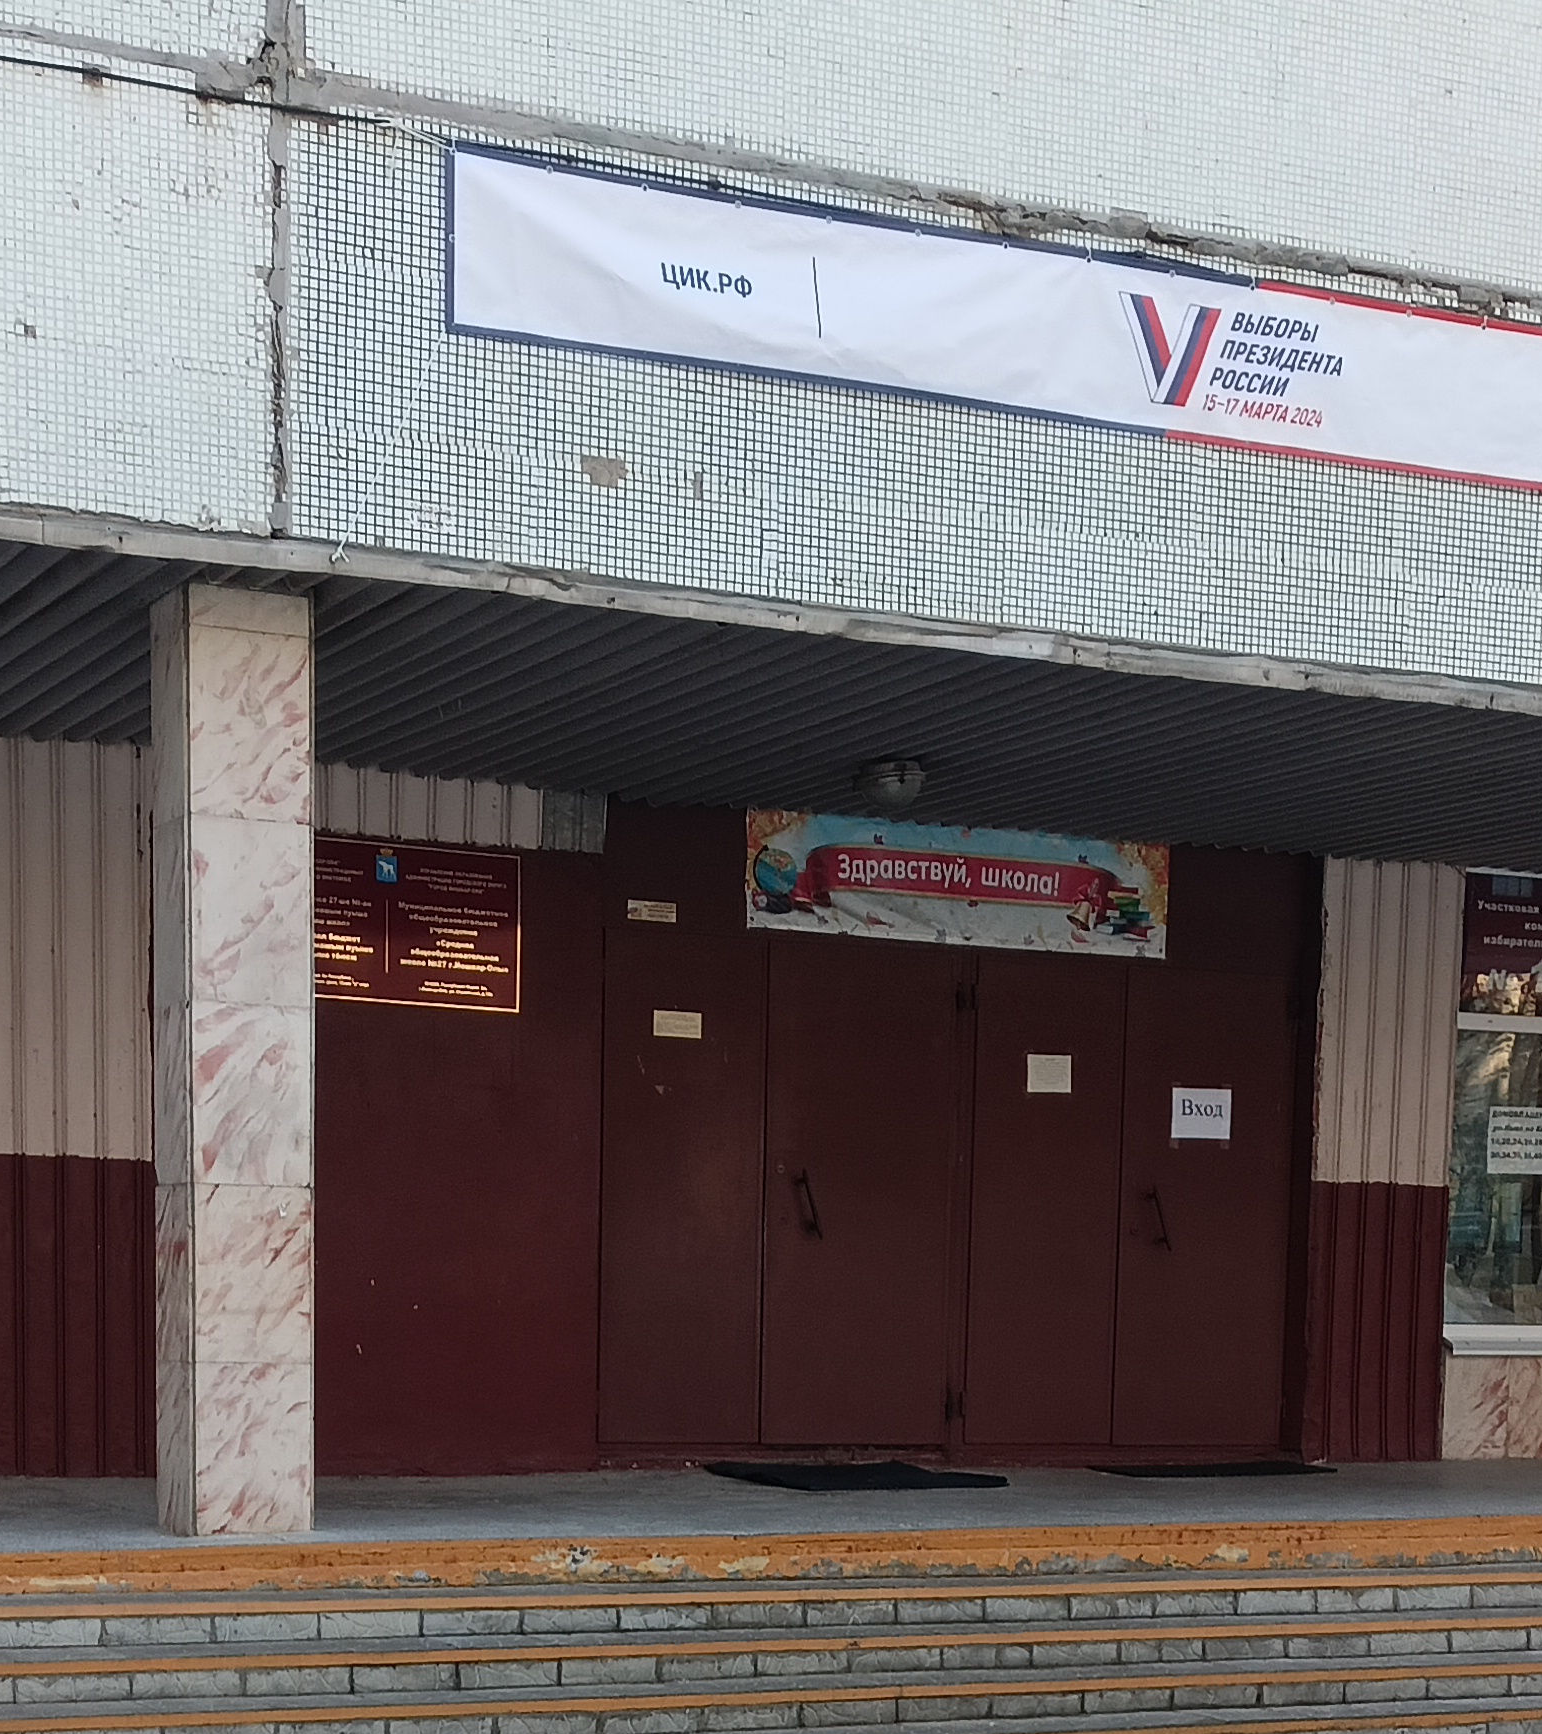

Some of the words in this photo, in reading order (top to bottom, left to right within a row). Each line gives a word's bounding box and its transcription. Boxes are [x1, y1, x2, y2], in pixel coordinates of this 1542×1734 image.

[660, 261, 753, 299] ЦИК.РФ
[1230, 311, 1320, 343] ВЫБОРЫ
[1219, 339, 1344, 377] ПРЕЗИДЕНТА
[1209, 366, 1291, 398] РОССИИ
[1238, 399, 1290, 424] МАРТА
[1290, 406, 1324, 428] 2024
[837, 853, 972, 889] Здравствуй,
[980, 865, 1060, 897] школа!
[1477, 899, 1540, 914] Участковая
[1181, 1098, 1224, 1119] Вход
